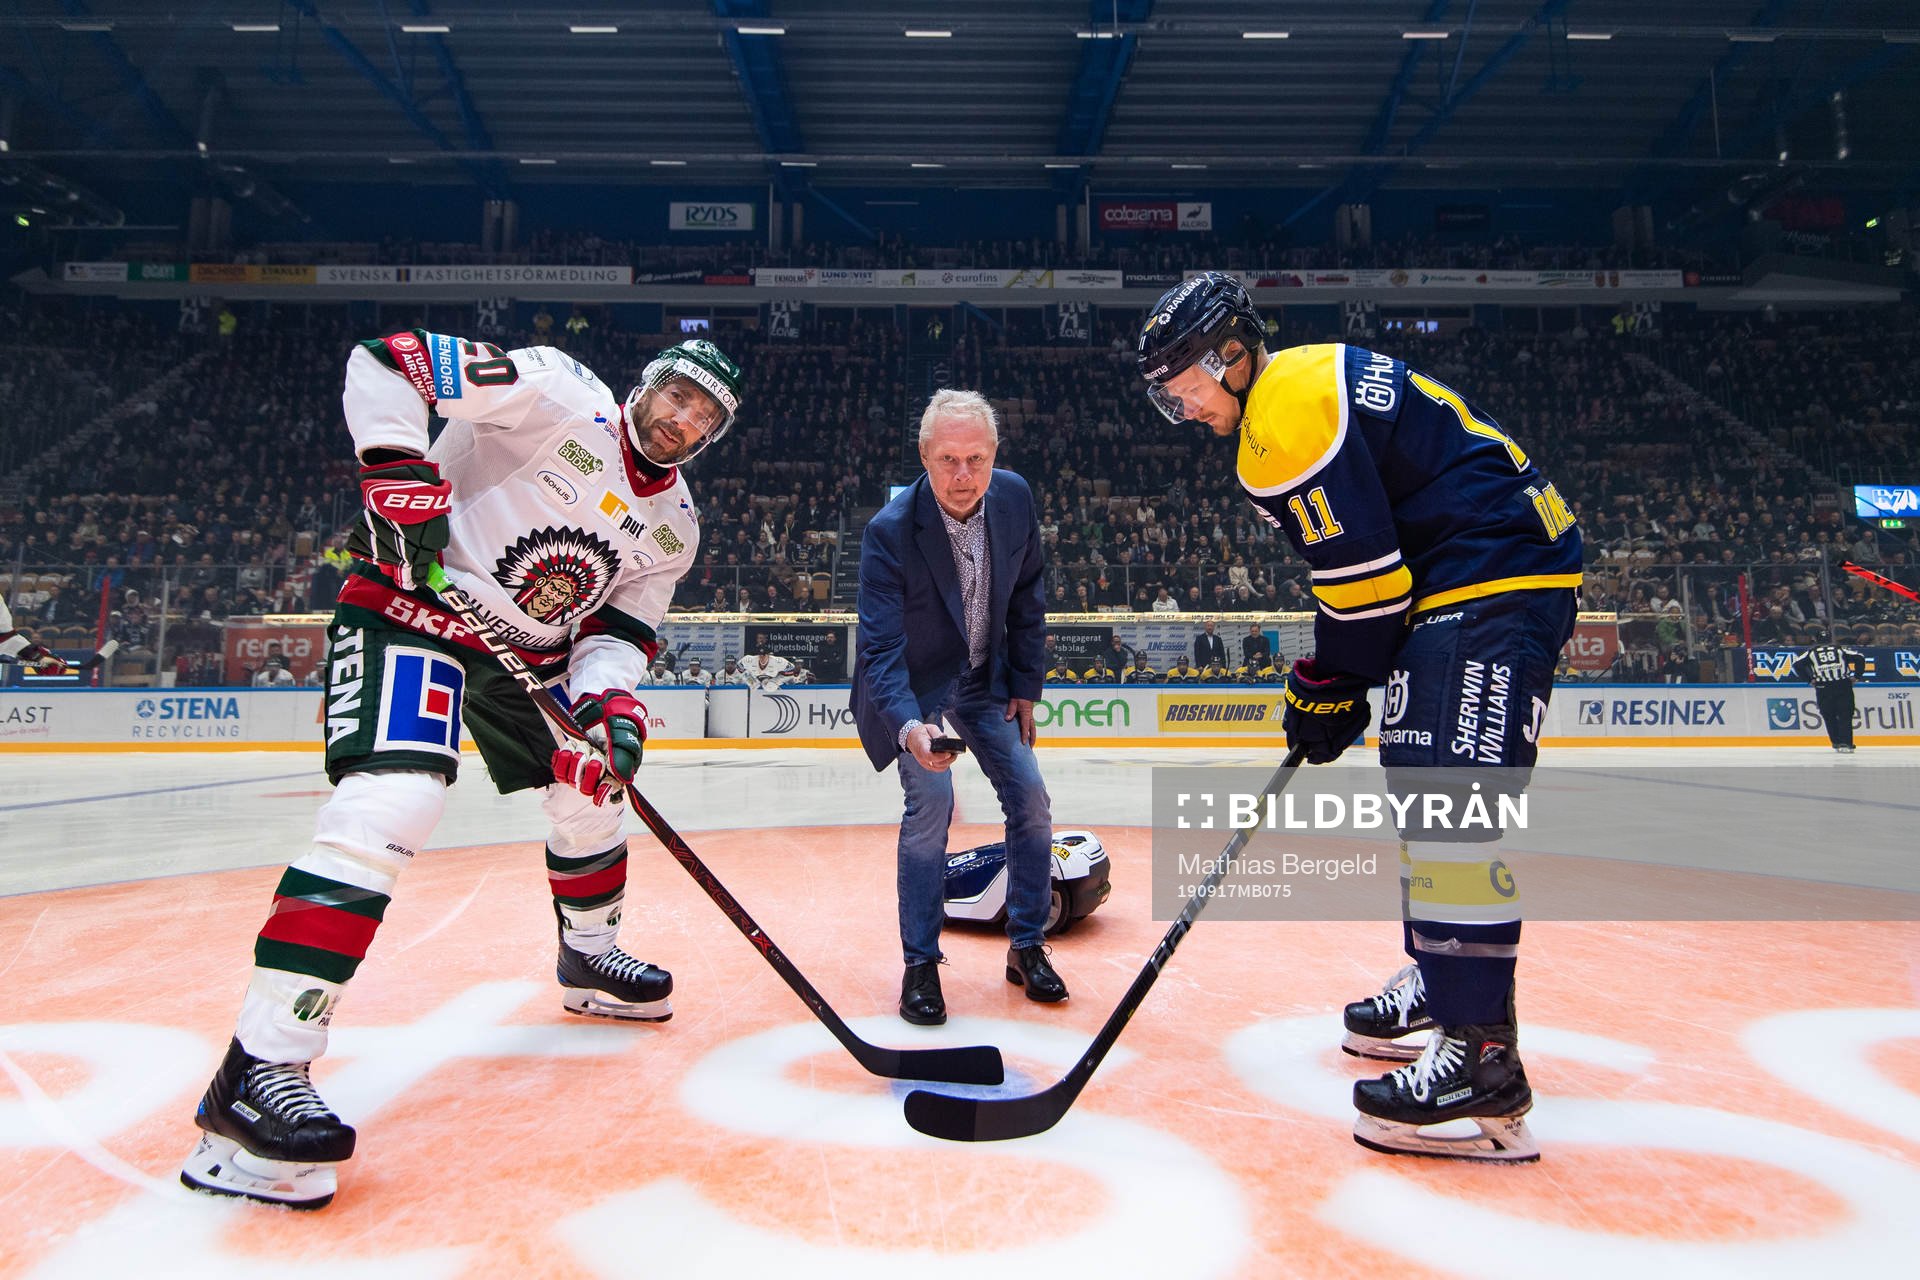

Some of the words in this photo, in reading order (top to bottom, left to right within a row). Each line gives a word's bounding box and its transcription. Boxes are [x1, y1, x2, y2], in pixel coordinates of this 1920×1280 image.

[686, 206, 737, 222] RYDS
[1104, 204, 1172, 221] colorama
[329, 269, 391, 281] SVENSK
[416, 268, 618, 281] FASTIGHETSFÖRMEDLING
[955, 272, 998, 282] eurofins
[1166, 277, 1205, 313] RAVEMA
[771, 312, 790, 329] 71
[1059, 313, 1079, 331] 71
[1347, 313, 1366, 330] 71
[413, 351, 438, 401] TURKISH
[690, 366, 738, 411] BJURFOR
[557, 447, 595, 476] BUDDY
[565, 439, 594, 464] CASH
[542, 474, 571, 502] BOHUS
[635, 470, 648, 484] SHL
[1288, 485, 1343, 545] 11
[651, 529, 677, 556] BUDDY
[659, 523, 679, 547] CASH
[384, 596, 474, 641] SKF
[459, 590, 567, 648] IVERBULLE
[1412, 612, 1465, 632] UER
[236, 634, 312, 657] renta
[441, 591, 544, 693] BAUER
[770, 633, 794, 641] lokalt
[1061, 634, 1102, 644] engagerat
[1819, 651, 1836, 663] 58
[1285, 680, 1354, 715] AUER
[1888, 692, 1911, 700] SKF
[159, 697, 240, 720] STENA
[1165, 704, 1267, 722] ROSENLUNDS
[1451, 660, 1485, 760] SHERWIN
[1478, 663, 1511, 766] WILLIAMS
[1611, 700, 1725, 725] RESINEX
[132, 725, 240, 738] RECYCLING
[386, 842, 416, 858] BAUER
[234, 1102, 258, 1121] BAUER
